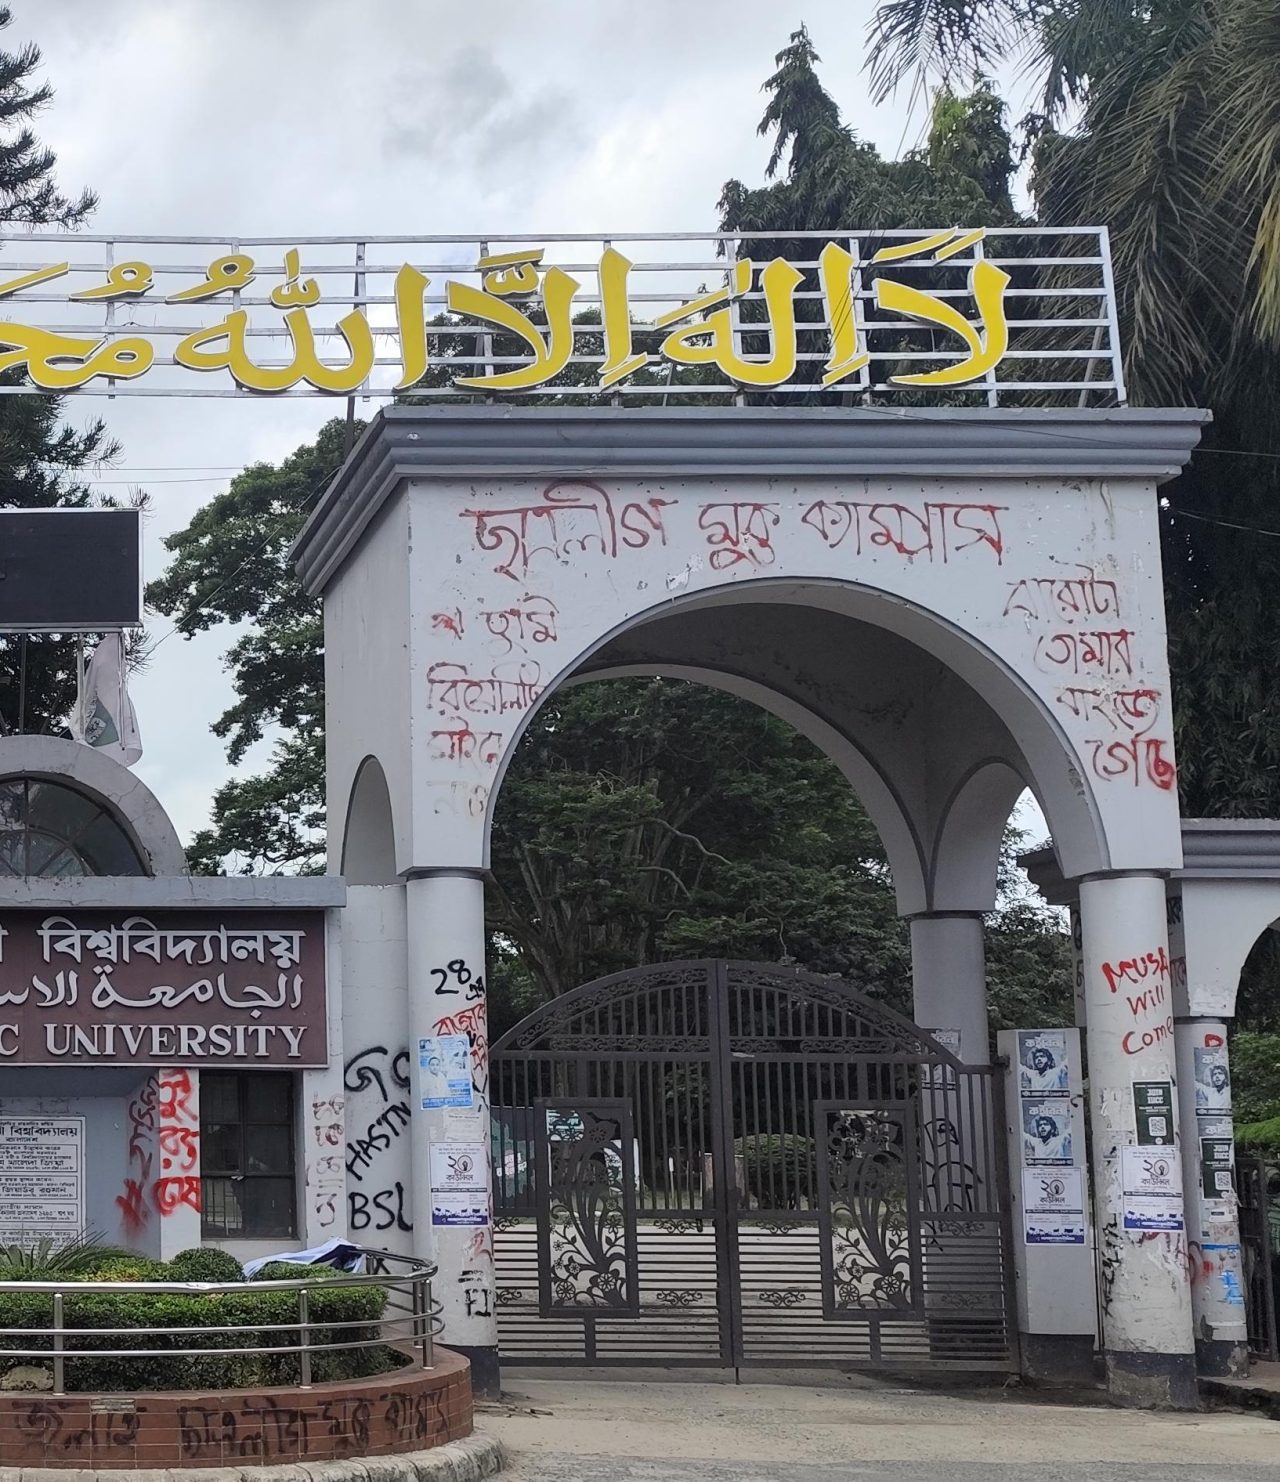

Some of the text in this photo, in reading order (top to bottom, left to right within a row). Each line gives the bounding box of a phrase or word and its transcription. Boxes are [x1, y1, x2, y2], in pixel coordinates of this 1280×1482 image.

[37, 915, 306, 969] বিশ্ববিদ্যালয়
[92, 965, 304, 1018] الجامعة
[430, 959, 472, 995] 28
[46, 1023, 308, 1057] UNIVERSITY
